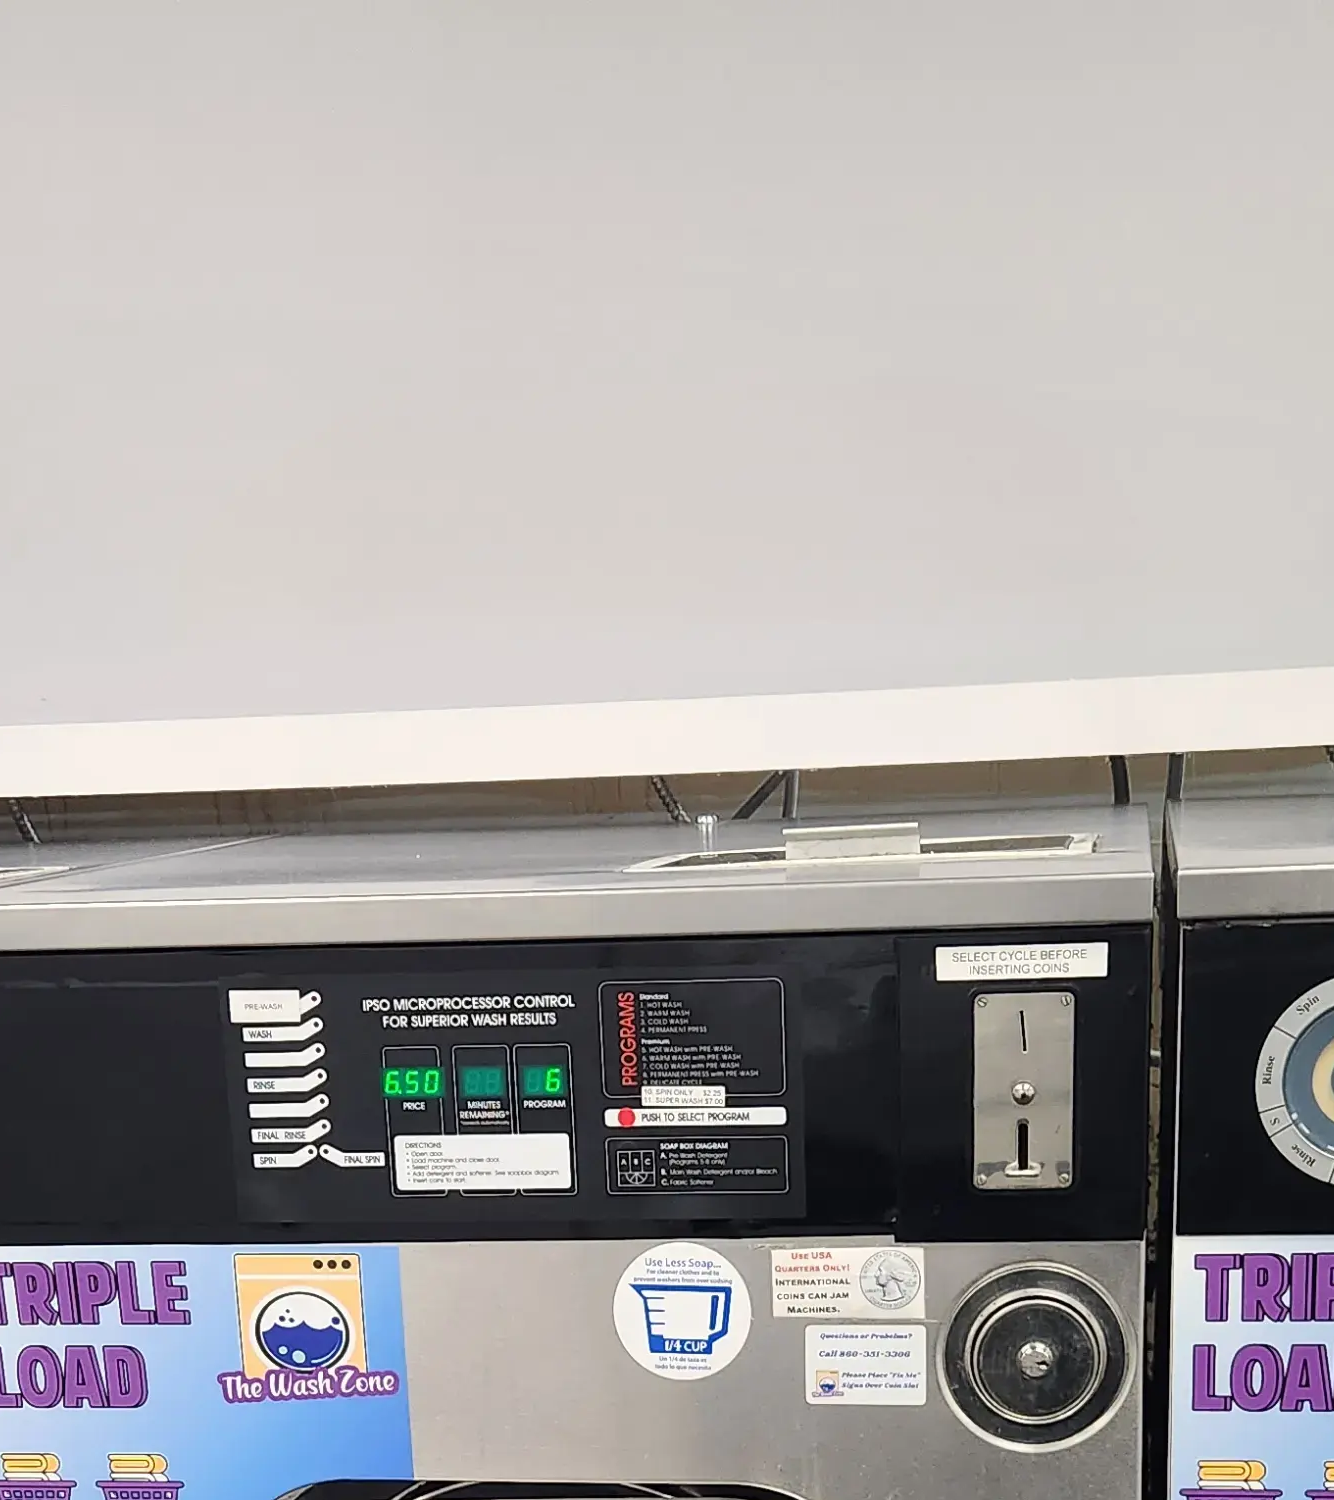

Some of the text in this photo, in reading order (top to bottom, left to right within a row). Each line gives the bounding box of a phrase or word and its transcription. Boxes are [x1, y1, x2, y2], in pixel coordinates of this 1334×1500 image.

[952, 949, 1087, 963] SELECT CYCLE BEFORE
[969, 963, 1069, 975] INSERTING COINS
[244, 1002, 283, 1010] PRE-WASH
[362, 996, 575, 1012] IPSO MICROPROCESSOR CONTROL
[1296, 995, 1320, 1015] Spin
[382, 1012, 557, 1028] FOR SUPERIOR WASH RESULTS
[248, 1030, 273, 1039] WASH
[618, 991, 638, 1086] PROGRAMS
[253, 1081, 275, 1090] RINSE
[384, 1069, 440, 1095] 6.50
[403, 1101, 426, 1111] PRICE
[524, 1100, 566, 1108] PROGRAM
[641, 1112, 750, 1122] PUSH TO SELECT PROGRAM
[257, 1131, 306, 1140] FINAL RINSE
[260, 1156, 277, 1165] SPIN
[344, 1155, 381, 1164] FINAL SPIN
[645, 1258, 663, 1267] Use
[665, 1258, 686, 1267] Less
[664, 1340, 708, 1352] 1/4 CUP
[221, 1369, 395, 1400] The Wash Zone
